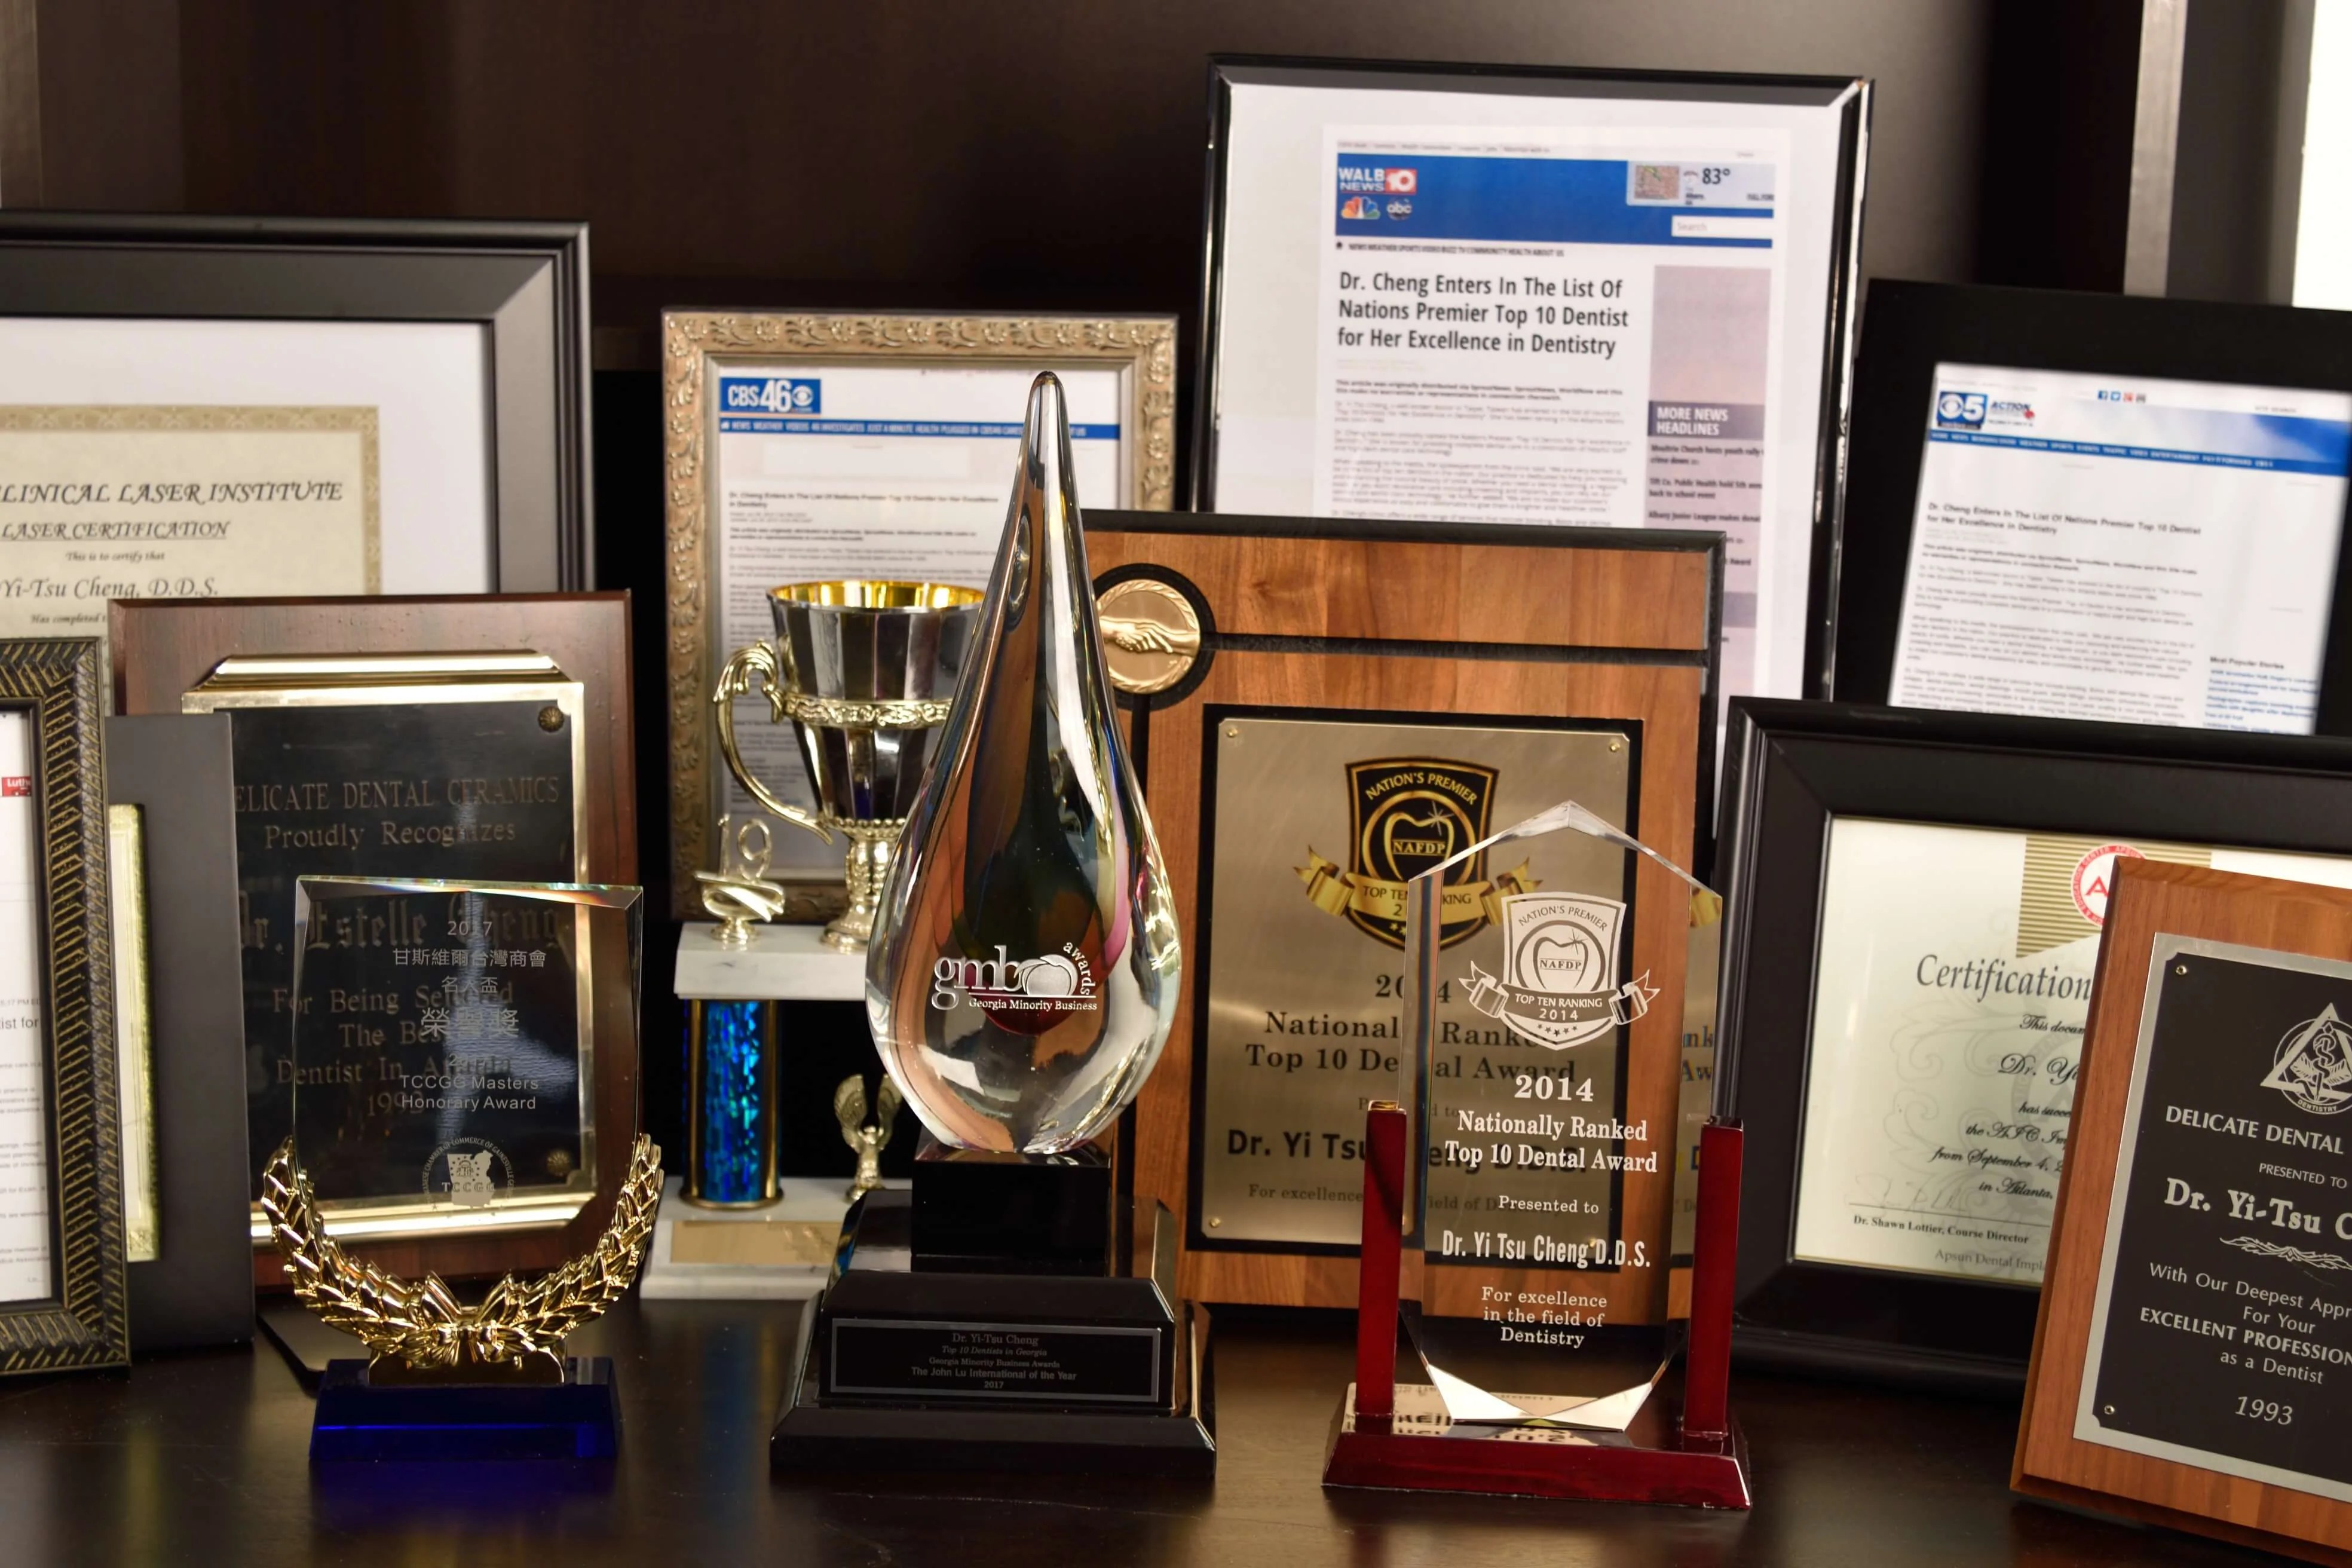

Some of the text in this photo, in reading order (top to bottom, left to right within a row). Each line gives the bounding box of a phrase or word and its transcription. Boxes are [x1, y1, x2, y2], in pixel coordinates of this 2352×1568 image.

[1338, 167, 1416, 192] WALB 10
[1340, 182, 1385, 191] NEWS
[1386, 201, 1413, 215] abc
[1677, 222, 1707, 231] Search
[1340, 272, 1622, 298] Dr. Cheng Enters In The List Of
[1339, 300, 1628, 328] Nations Premier Top 10 Dentist
[1338, 327, 1615, 359] for Her Excellence in Dentistry
[1656, 407, 1728, 421] MORE NEWS
[1962, 395, 1985, 422] 5
[1656, 422, 1720, 435] HEADLINES
[118, 482, 208, 507] LASER
[209, 480, 343, 503] INSTITUTE
[2, 520, 231, 540] LASER CERTIFICATION
[1959, 517, 2057, 535] Excellence Dentistry
[112, 550, 165, 564] certify that
[1, 576, 66, 598] Yi-Tsu
[149, 577, 219, 597] D.D.S.
[52, 612, 99, 626] completed
[234, 776, 559, 813] ELICATE DENTAL CERAMICS
[1365, 773, 1478, 805] NATION'S PREMIER
[265, 822, 365, 850] Proudly
[1393, 840, 1447, 855] NAFDP
[1363, 884, 1387, 898] TOP
[1519, 905, 1608, 932] NATION'S PREMIER
[1063, 942, 1096, 996] awards
[1539, 959, 1582, 969] NAFDP
[1916, 954, 2091, 1003] Certification
[329, 988, 400, 1015] Being
[969, 998, 1097, 1013] Georgia Minority Business
[1515, 993, 1603, 1007] TOP TEN RANKING
[1264, 1011, 1399, 1039] National
[1539, 1008, 1579, 1021] 2014
[2019, 1013, 2048, 1031] This
[339, 1022, 385, 1048] The
[1245, 1043, 1347, 1073] Top 10
[1998, 1053, 2036, 1076] Dr.
[277, 1058, 363, 1086] Dentist
[471, 1074, 539, 1090] Masters
[1514, 1074, 1594, 1102] 2014
[402, 1095, 537, 1113] Honorary Award
[2298, 1098, 2338, 1113] DENTISTRY
[1457, 1110, 1647, 1141] Nationally Ranked
[2166, 1105, 2344, 1155] DELICATE DENTAL
[1228, 1129, 1311, 1159] Dr. Yi
[1444, 1140, 1658, 1172] Top 10 Dental Award
[1967, 1149, 2032, 1170] September
[2259, 1162, 2348, 1190] PRESENTED TO
[1248, 1183, 1276, 1199] For
[1498, 1195, 1599, 1214] Presented to
[2164, 1177, 2211, 1211] Dr.
[2227, 1189, 2321, 1234] Yi-Tsu
[1854, 1215, 1868, 1226] Dr.
[1871, 1217, 1905, 1230] Shawn
[1947, 1226, 1984, 1239] Course
[1987, 1230, 2029, 1244] Director
[1443, 1230, 1651, 1269] Dr. Yi Tsu Cheng D.D.S.
[1976, 1252, 2012, 1269] Dental
[2149, 1261, 2188, 1284] With
[2195, 1272, 2228, 1292] Our
[2236, 1281, 2304, 1309] Deepest
[1481, 1286, 1607, 1308] For excellence
[1483, 1307, 1605, 1327] in the field of
[2140, 1306, 2237, 1341] EXCELLENT
[2243, 1305, 2316, 1334] For Your
[952, 1333, 1039, 1347] Dr. Yi-Tsu Cheng
[1500, 1327, 1585, 1349] Dentistry
[929, 1356, 1061, 1369] Georgia Minority Business Awards
[942, 1345, 1048, 1358] Top Dentists Georgia
[911, 1367, 1077, 1382] The John Lu International the Year
[2220, 1351, 2323, 1385] as a Dentist
[984, 1380, 1004, 1390] 2017
[2235, 1396, 2293, 1426] 1993
